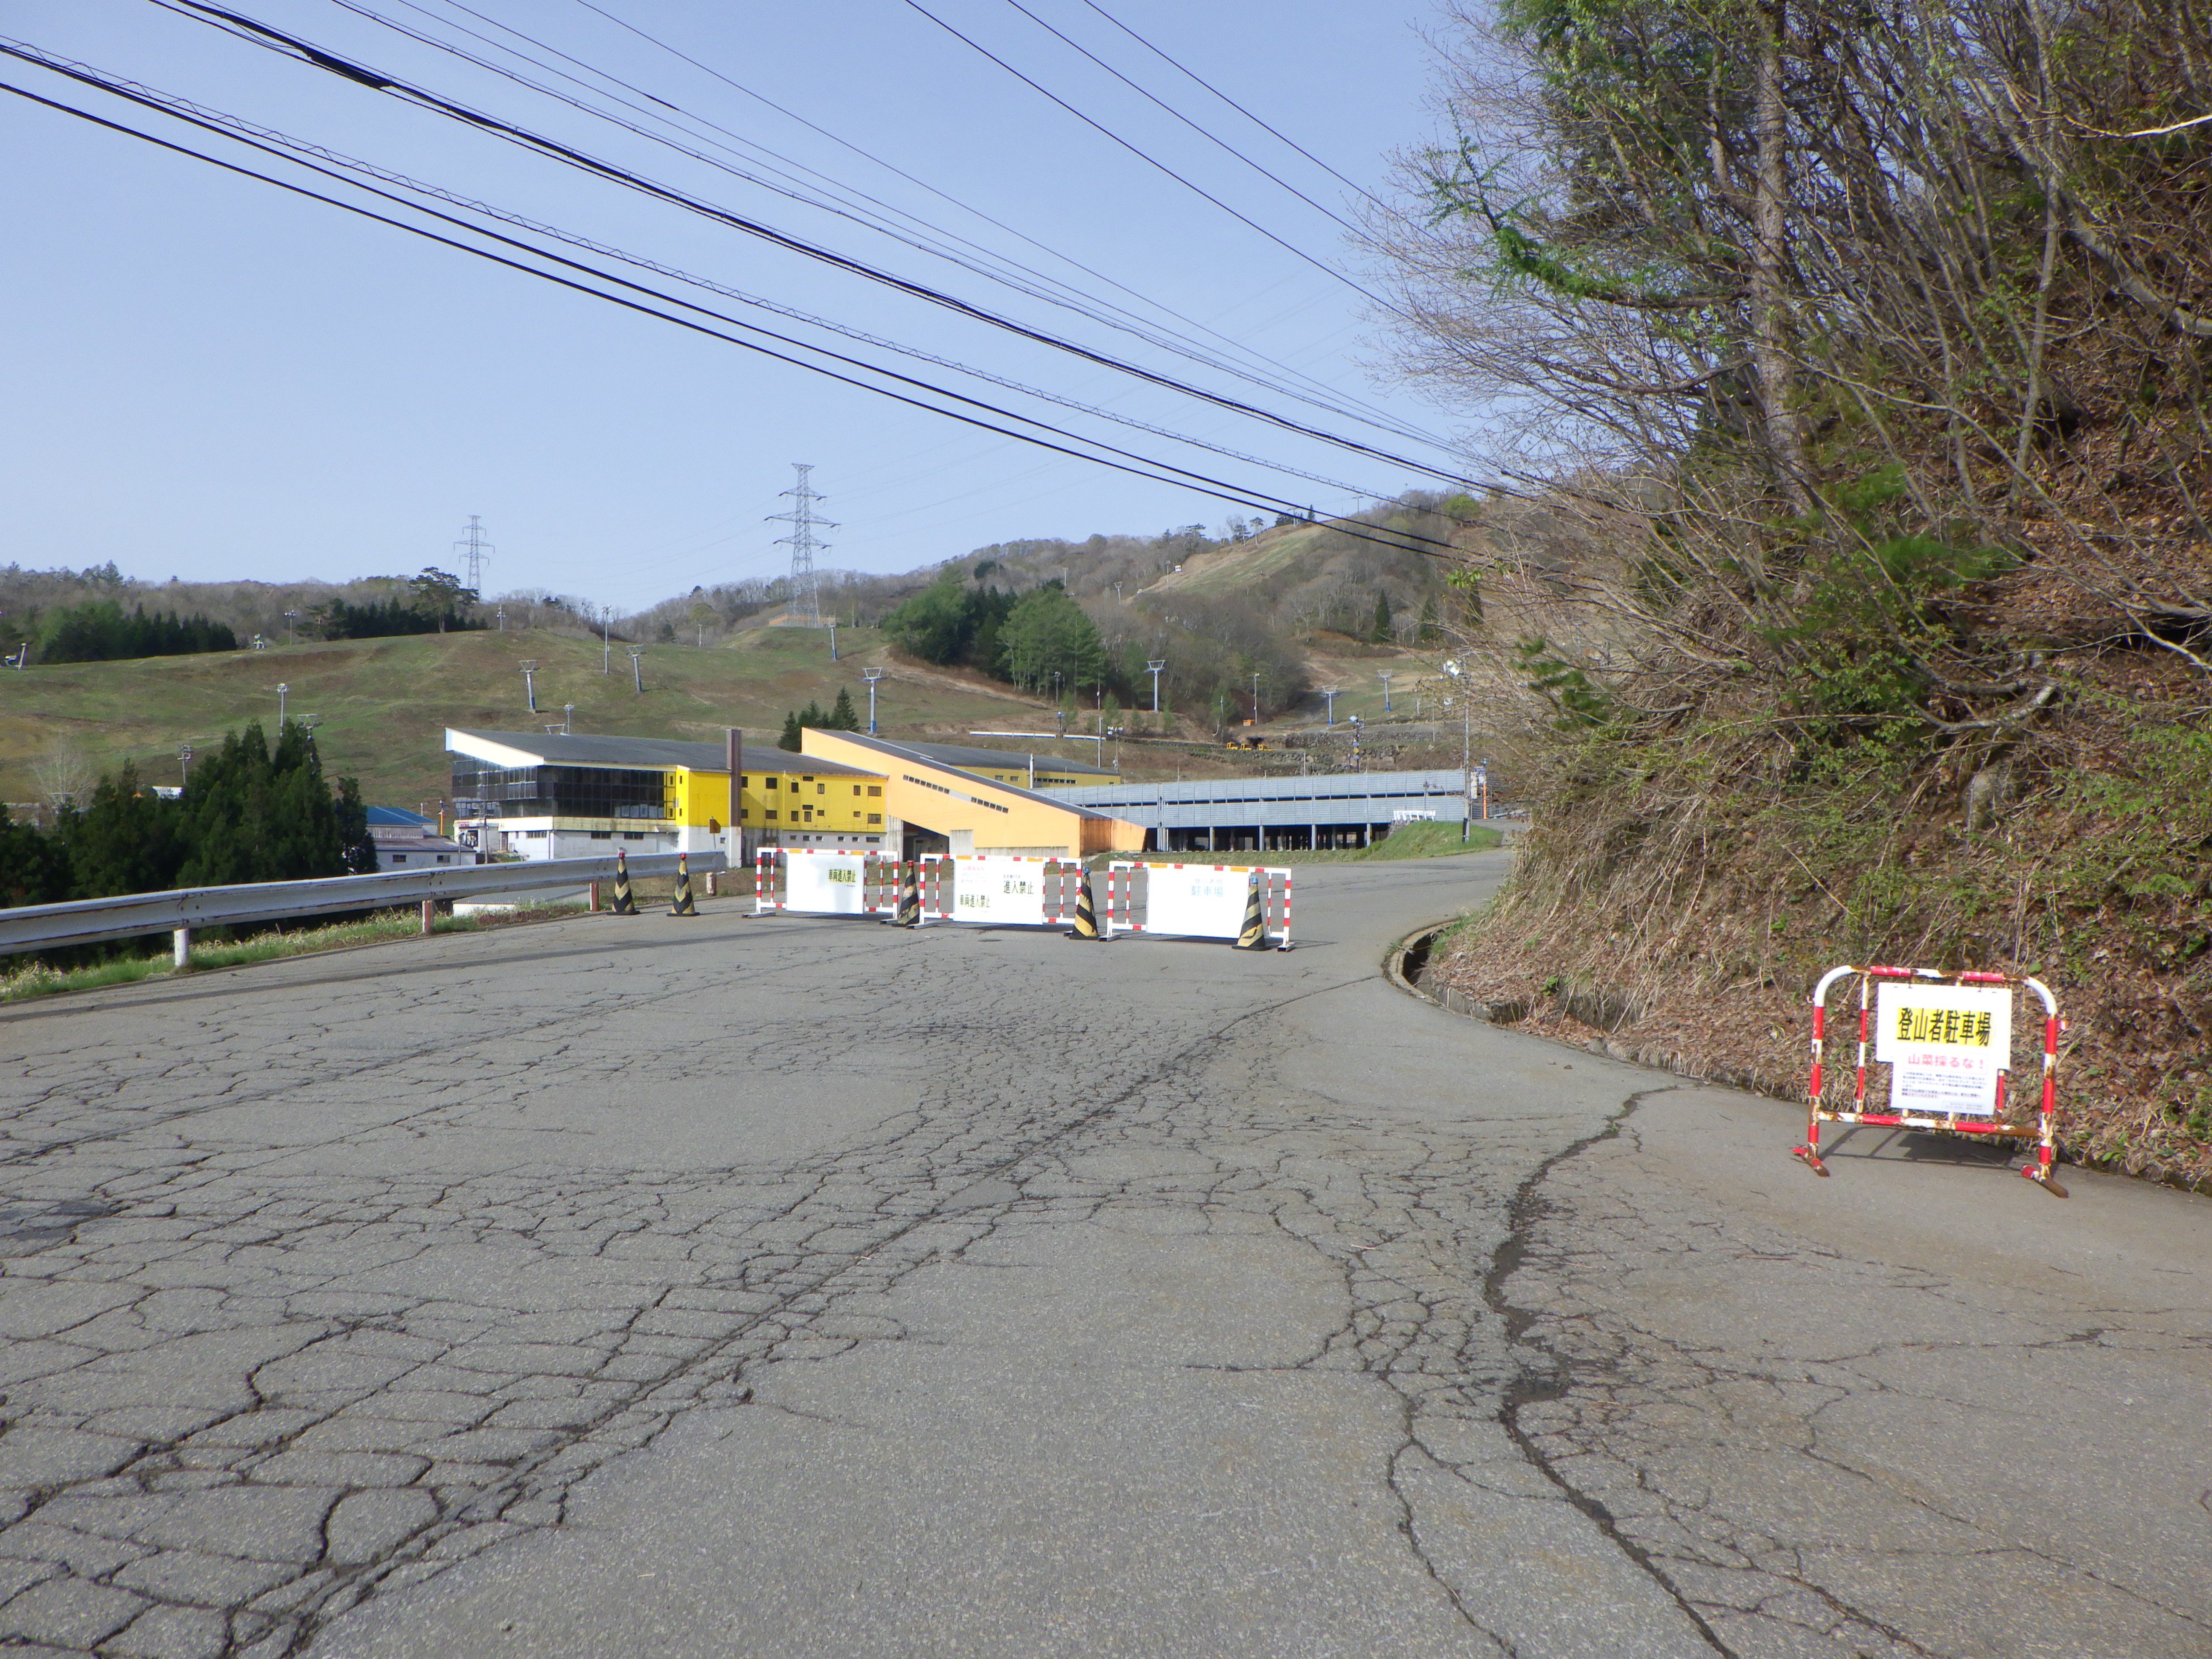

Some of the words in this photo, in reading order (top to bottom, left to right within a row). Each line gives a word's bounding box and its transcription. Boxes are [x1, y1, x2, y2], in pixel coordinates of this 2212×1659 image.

[828, 868, 856, 882] 車両進入禁止
[1004, 880, 1034, 894] 進入禁止
[1191, 885, 1223, 897] 駐車場
[960, 894, 990, 908] 車両進入禁止
[1897, 1007, 1991, 1047] 登山者駐車場
